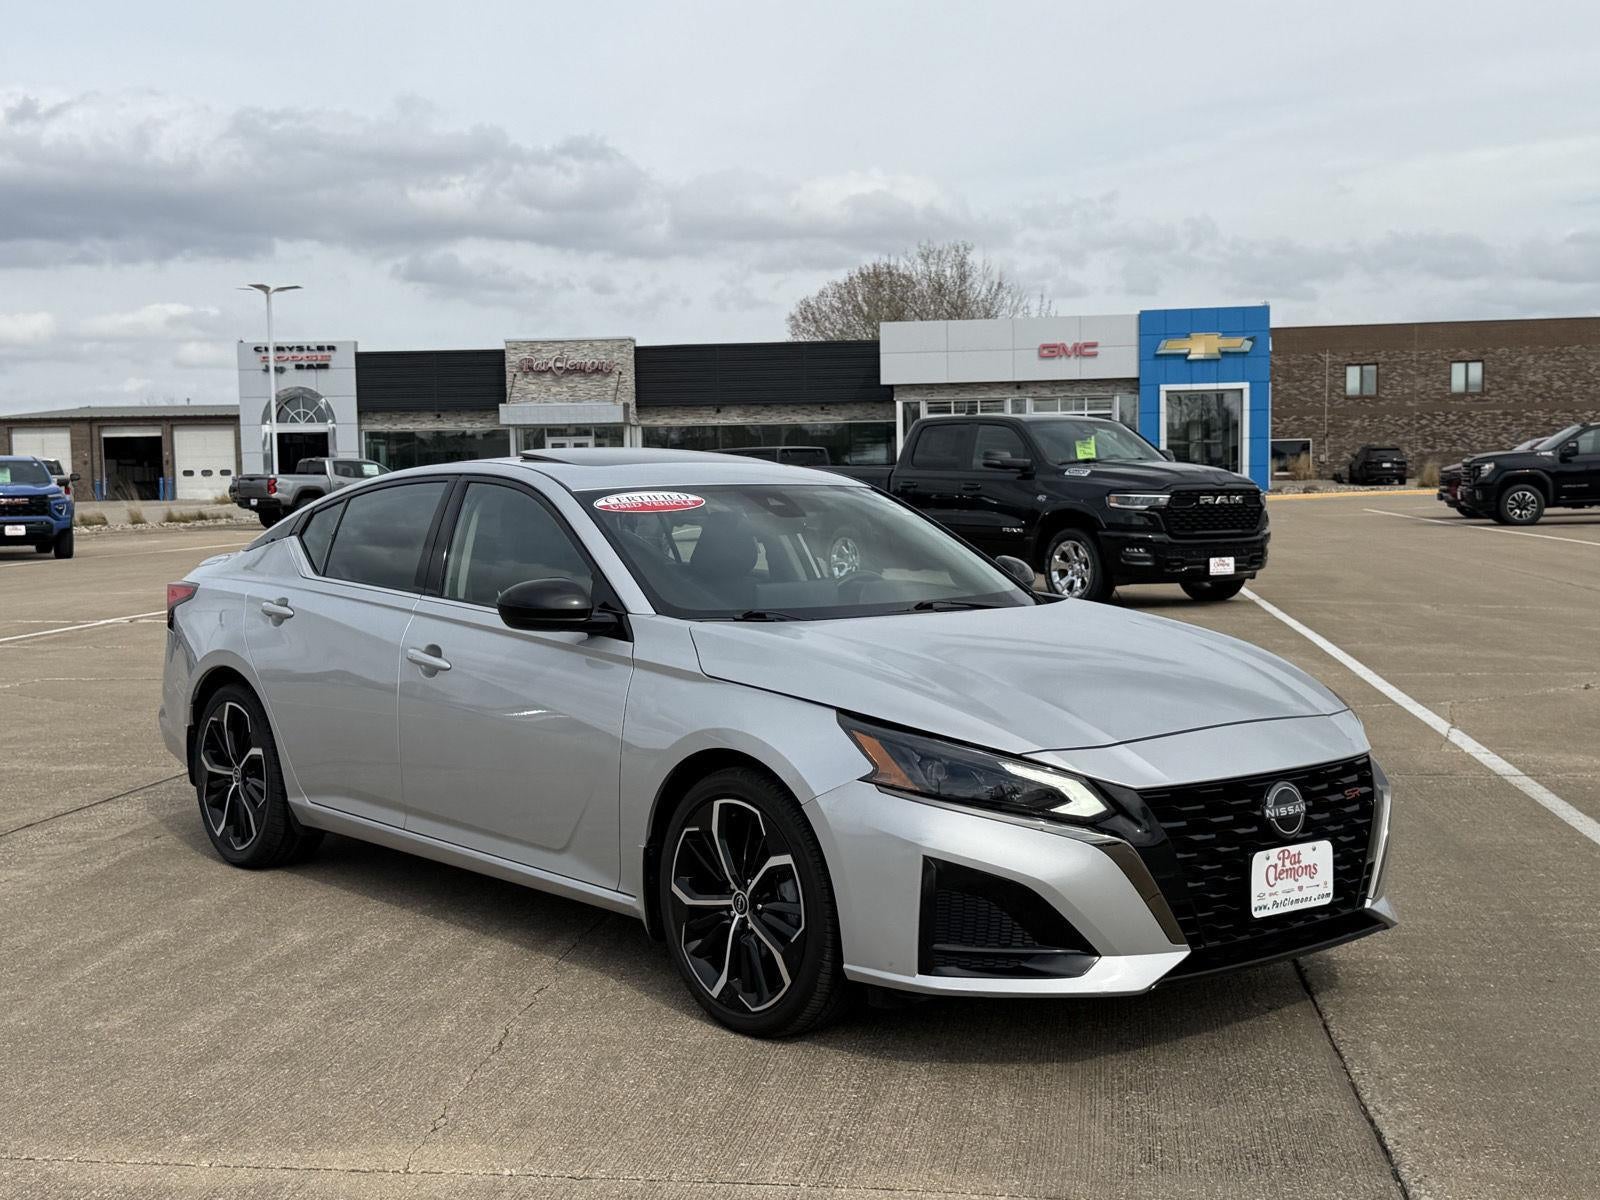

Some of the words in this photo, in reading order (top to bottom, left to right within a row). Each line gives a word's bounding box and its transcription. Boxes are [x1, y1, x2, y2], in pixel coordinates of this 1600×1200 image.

[1039, 341, 1098, 358] GMC
[520, 355, 549, 373] Pat
[551, 355, 616, 376] Clemons
[604, 493, 690, 504] CERTIFIED
[609, 502, 642, 510] USED
[645, 499, 695, 507] VEHICLE
[1199, 495, 1243, 505] RAM
[1344, 787, 1361, 800] SR
[1265, 803, 1306, 818] NISSAN
[1277, 848, 1302, 867] Pat
[1265, 863, 1318, 888] Clemons
[1253, 892, 1331, 912] www.PatClemons.com
